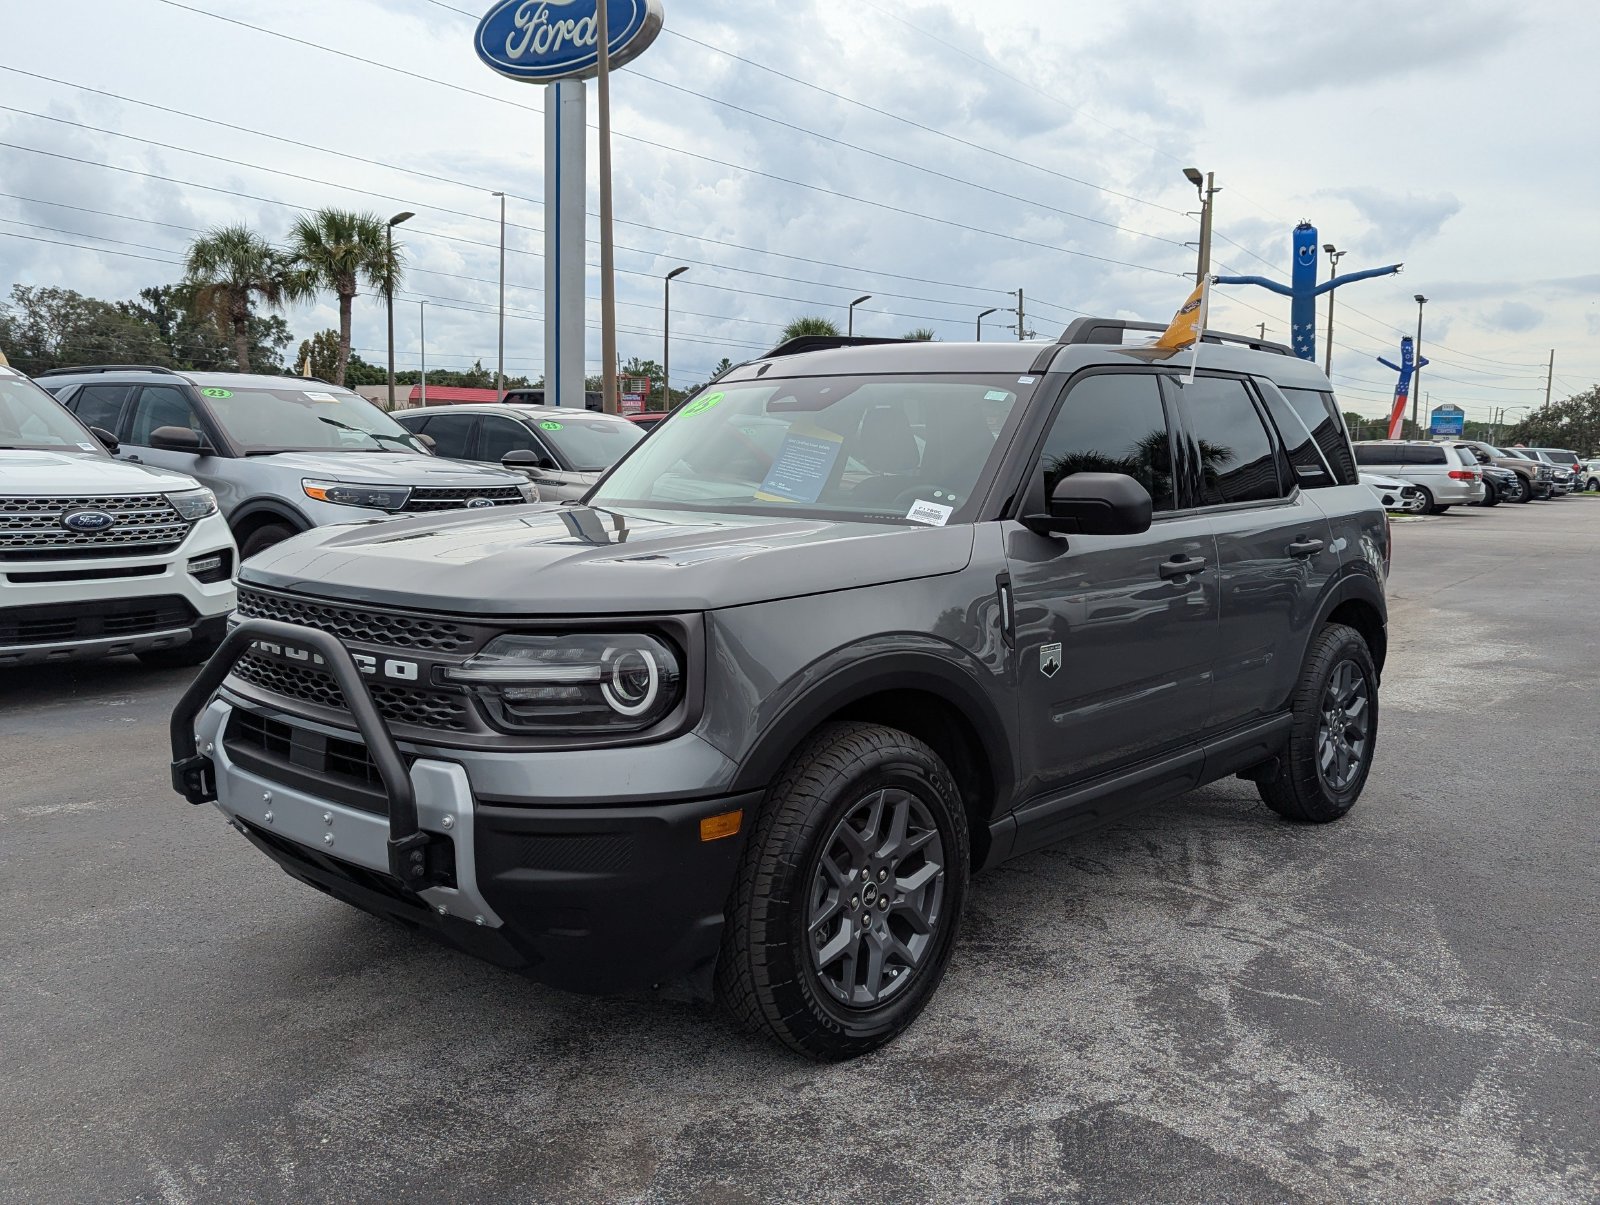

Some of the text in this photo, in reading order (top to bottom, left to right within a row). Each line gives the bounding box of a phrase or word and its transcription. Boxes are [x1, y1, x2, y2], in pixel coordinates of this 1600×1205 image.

[505, 0, 598, 59] Ford
[208, 389, 225, 397] 23
[77, 515, 104, 526] Ford
